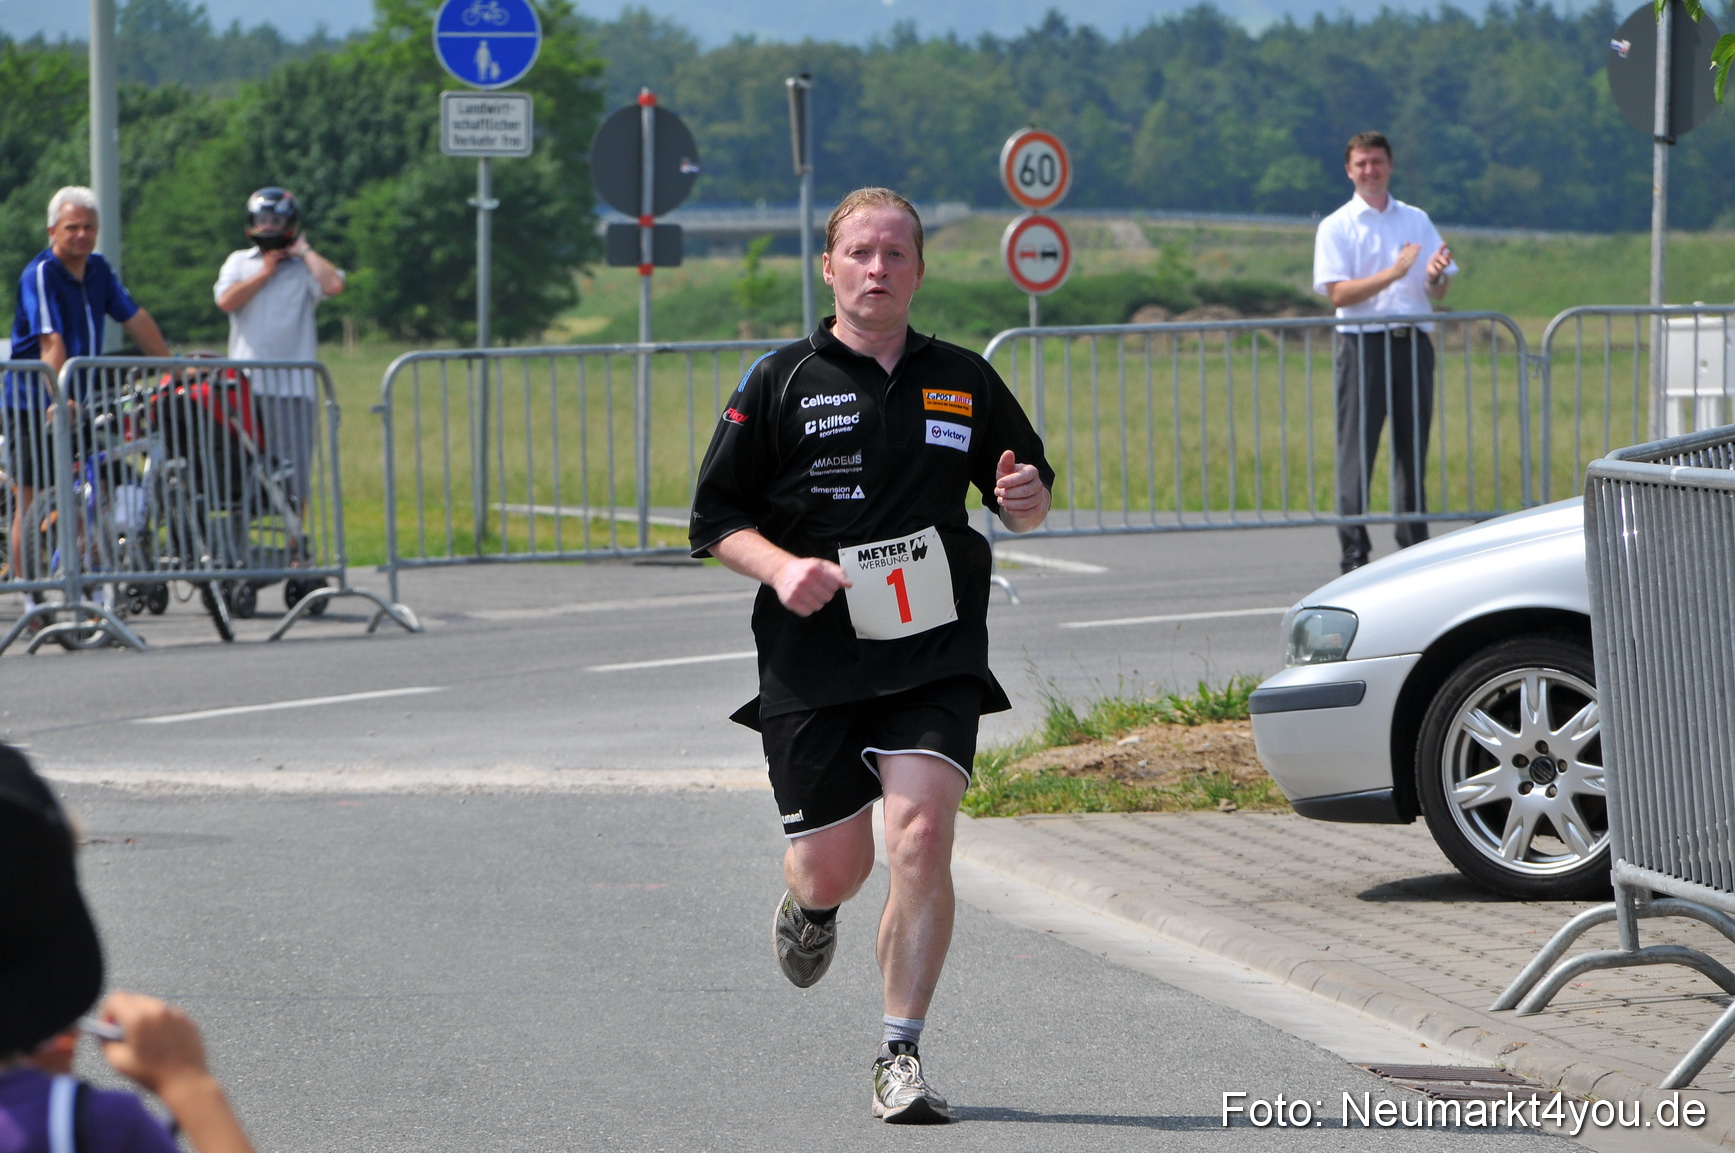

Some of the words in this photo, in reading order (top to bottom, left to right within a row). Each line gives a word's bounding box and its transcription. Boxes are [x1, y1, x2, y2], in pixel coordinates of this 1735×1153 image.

[1020, 153, 1056, 187] 60
[800, 392, 857, 408] Cellagon
[819, 412, 860, 431] killtec
[819, 425, 853, 438] sportswear
[942, 429, 967, 443] victory
[811, 454, 862, 469] AMADEUS
[810, 486, 851, 494] dimension
[832, 492, 851, 500] data
[857, 542, 908, 562] MEYER
[858, 553, 910, 570] WERBUNG
[886, 567, 913, 624] 1
